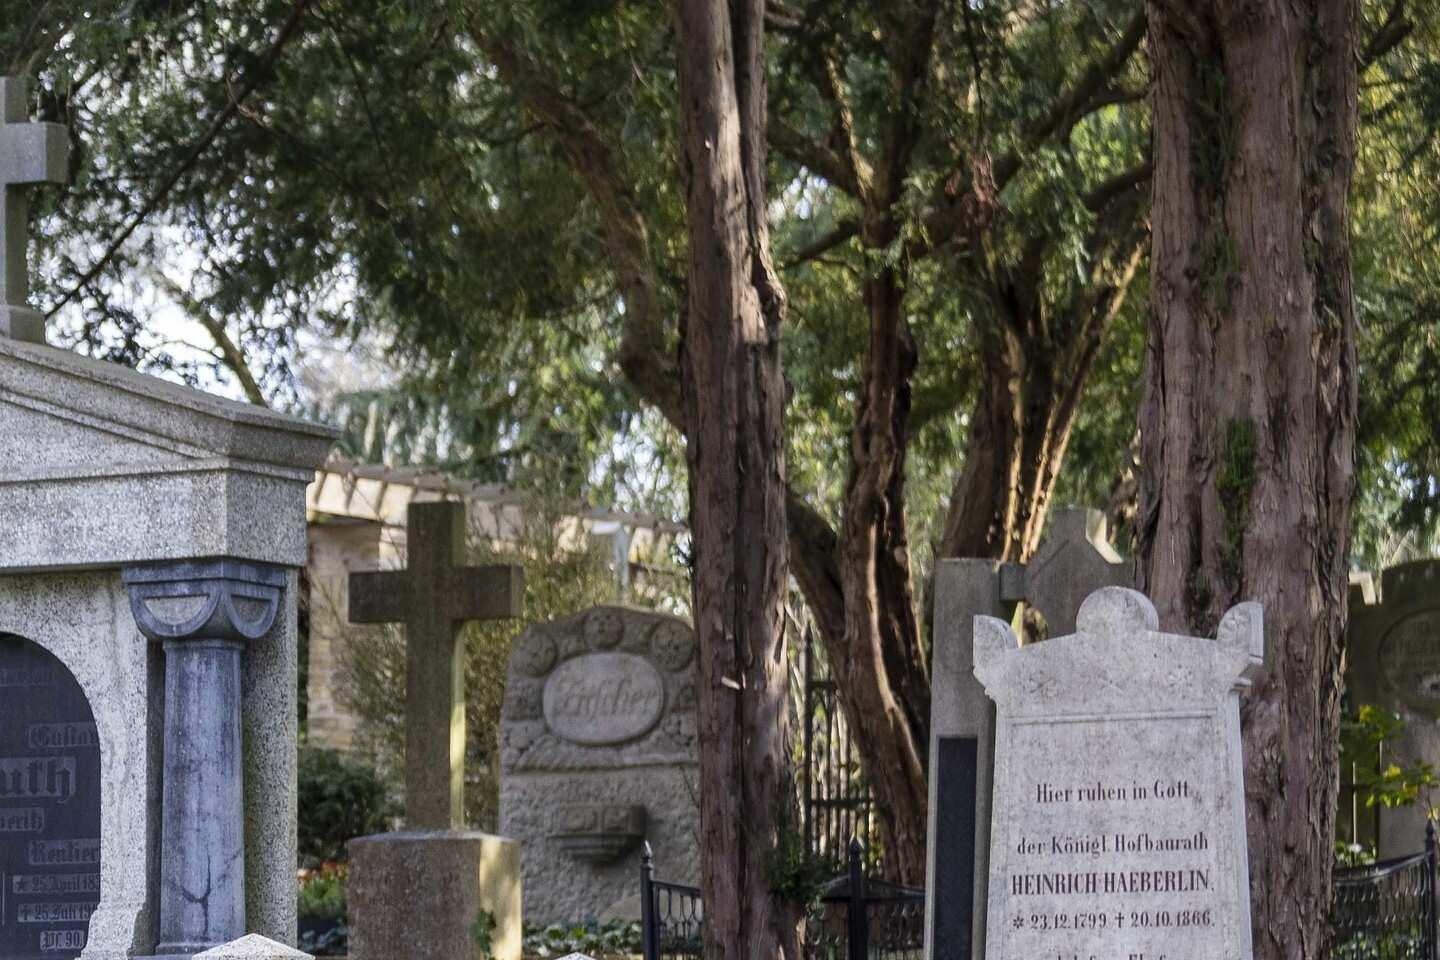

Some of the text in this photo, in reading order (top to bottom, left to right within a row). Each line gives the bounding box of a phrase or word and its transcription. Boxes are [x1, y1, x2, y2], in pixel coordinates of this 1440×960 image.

[1036, 783, 1073, 804] Hier
[1078, 781, 1127, 802] ruhen
[1132, 780, 1147, 801] in
[1017, 837, 1046, 855] der
[1114, 831, 1209, 853] Hofbaurath
[1011, 871, 1098, 896] HEINRICH
